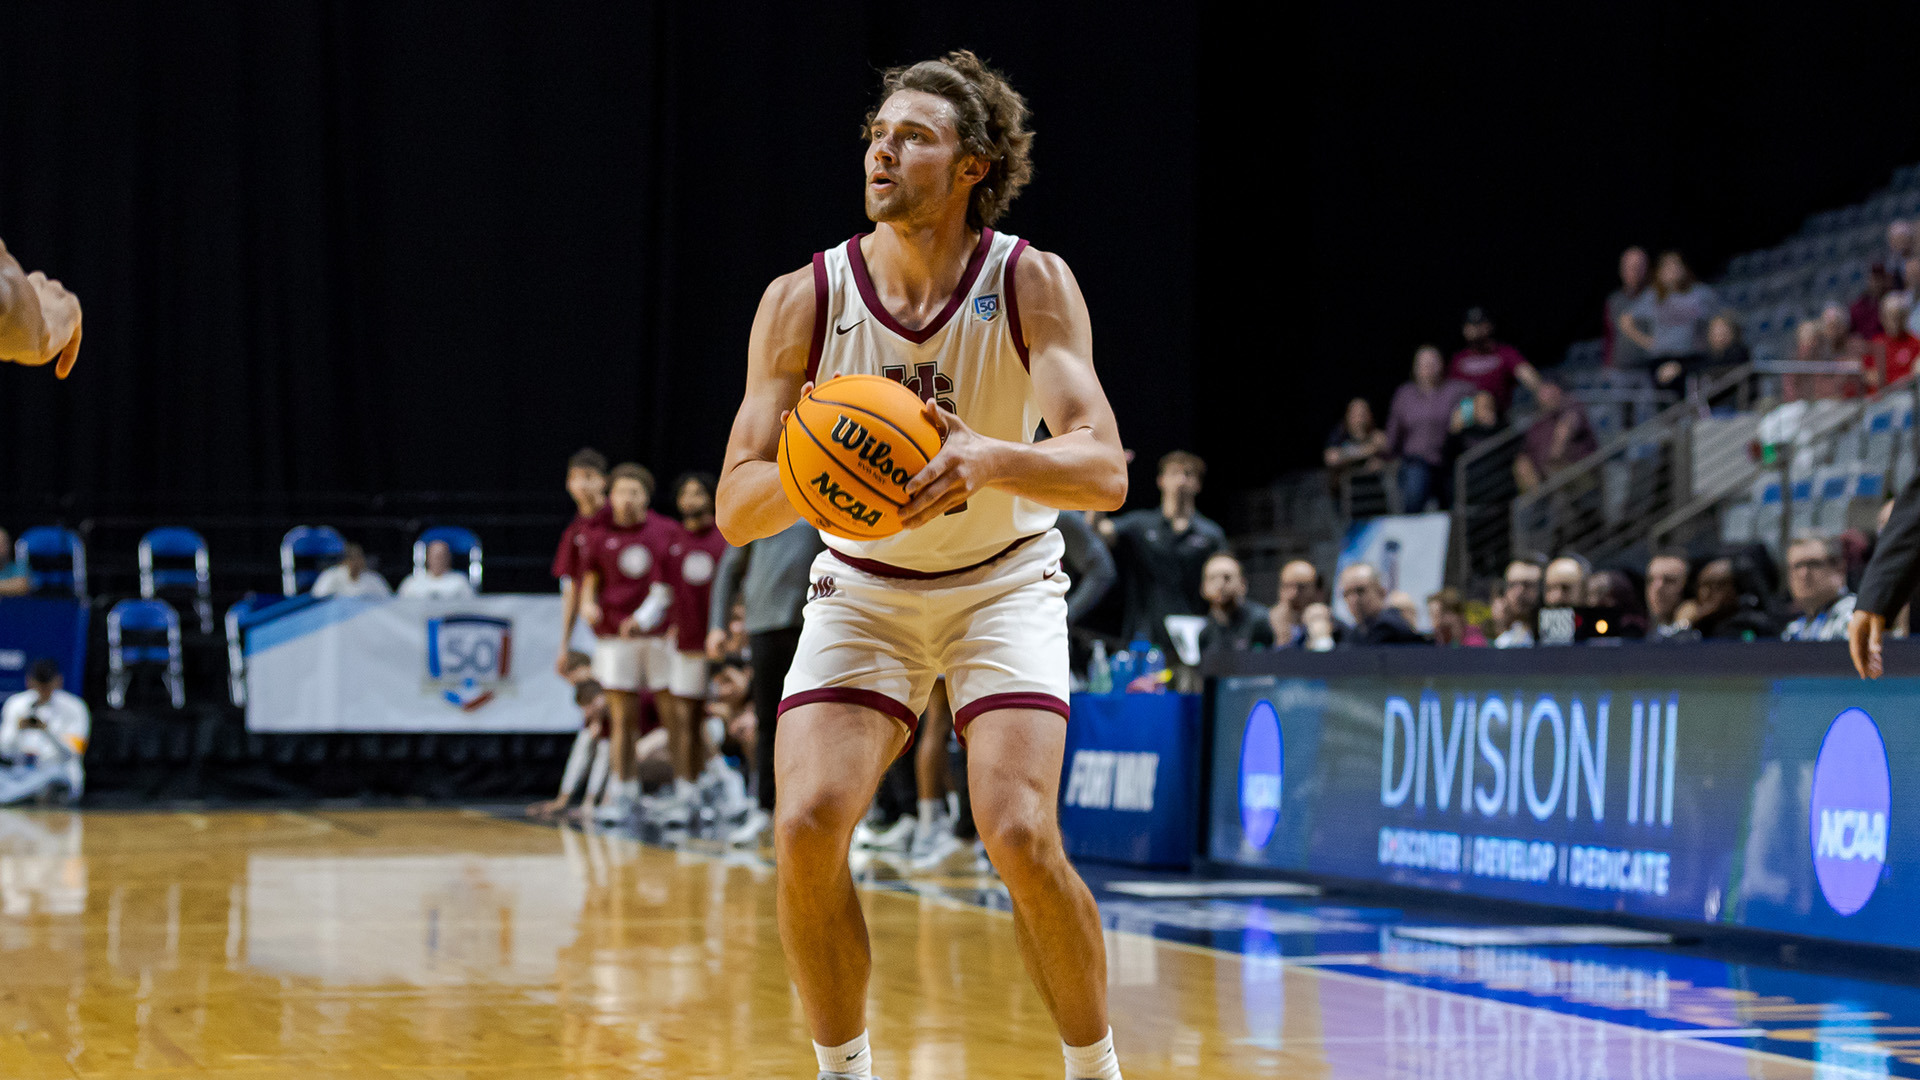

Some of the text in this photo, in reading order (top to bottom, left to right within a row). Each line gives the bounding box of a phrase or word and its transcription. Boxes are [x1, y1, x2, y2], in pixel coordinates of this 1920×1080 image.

[979, 300, 996, 313] 50
[831, 413, 914, 494] Wilso
[811, 471, 884, 527] NCAA
[445, 637, 496, 674] 50
[1381, 692, 1611, 823] DIVISION
[1816, 808, 1886, 863] NCAA
[1472, 835, 1557, 884] DEVELOP
[1569, 843, 1670, 897] DEDICATE
